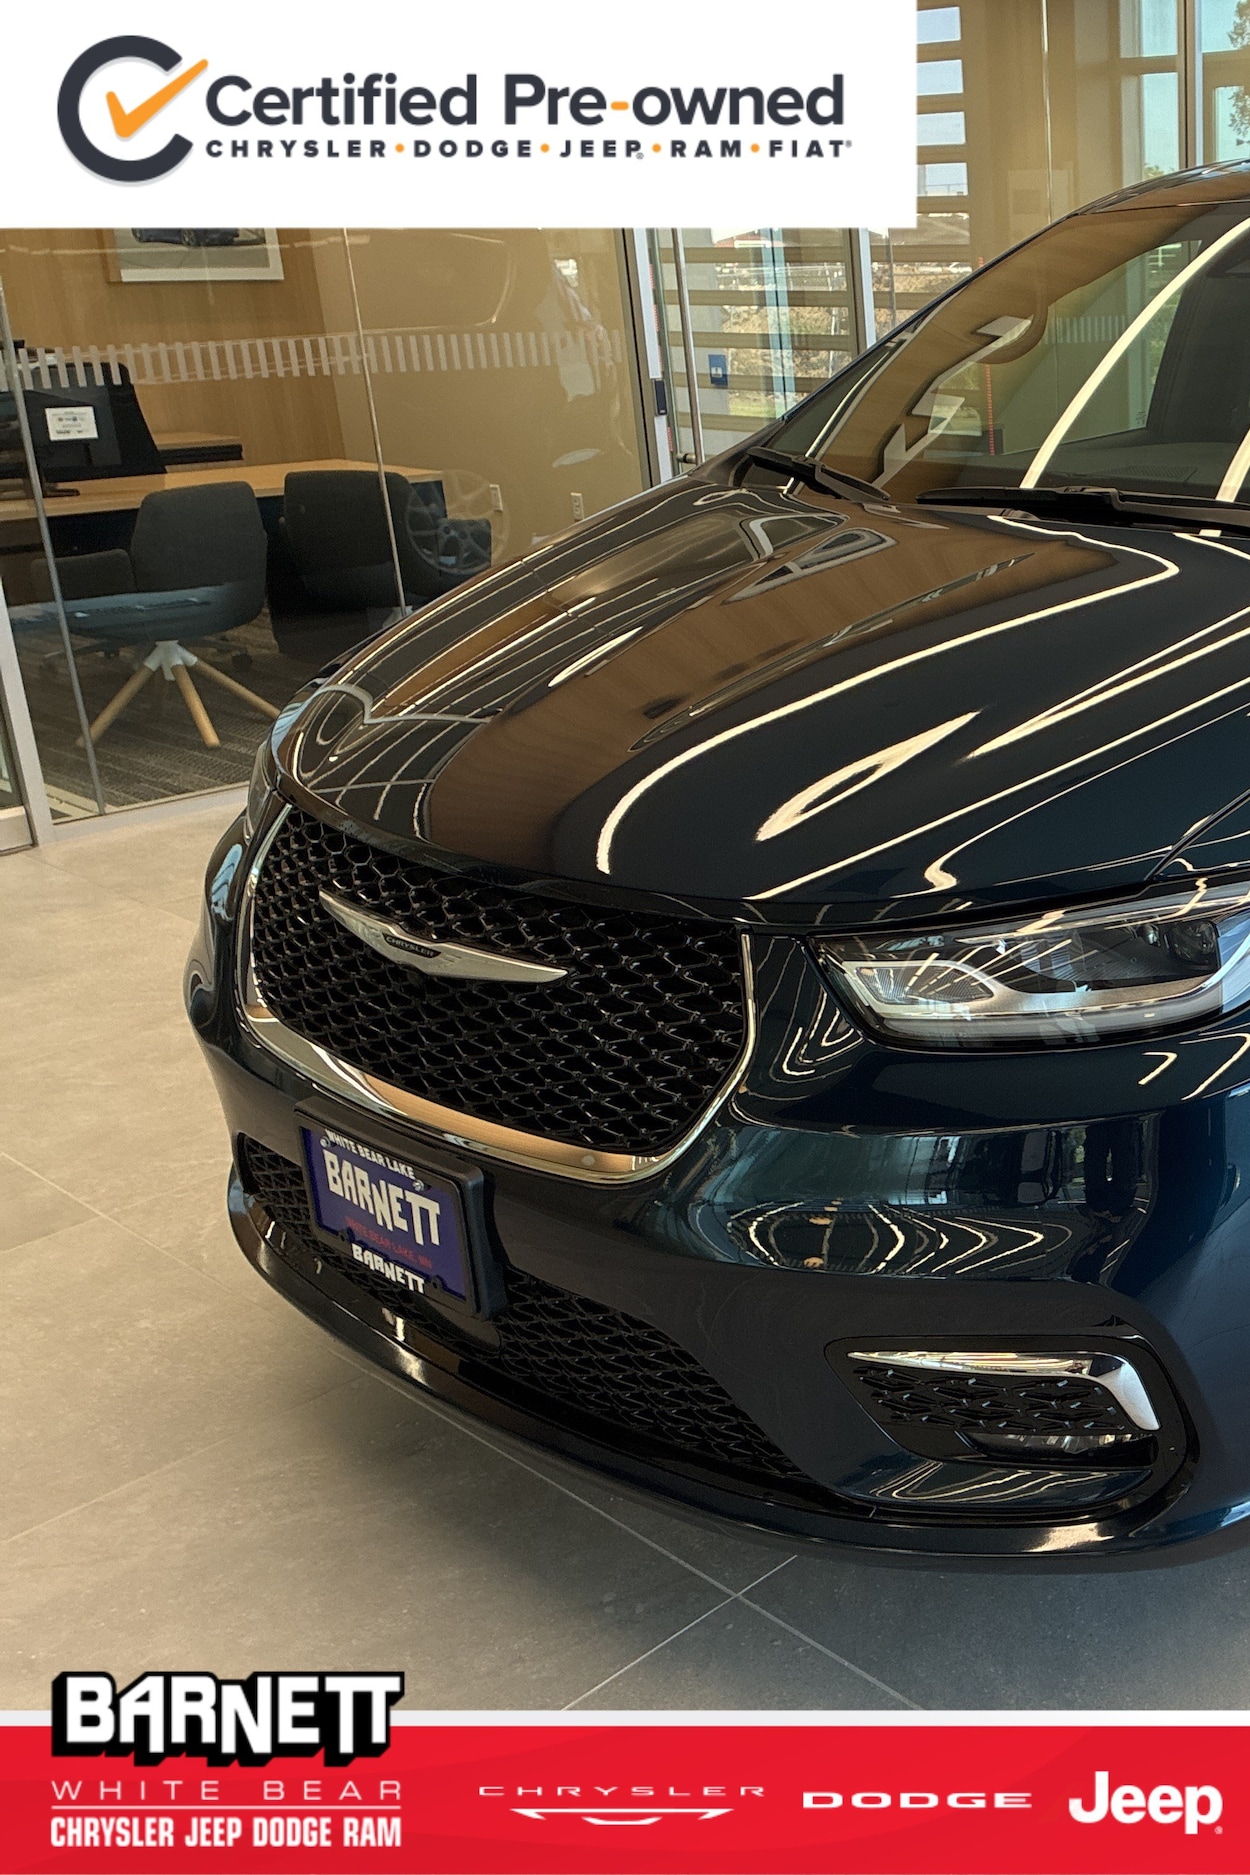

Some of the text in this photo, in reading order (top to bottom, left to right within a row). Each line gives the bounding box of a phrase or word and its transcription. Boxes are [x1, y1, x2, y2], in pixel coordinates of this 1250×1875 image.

[324, 1128, 416, 1180] WHITE BEAR LAKE
[322, 1149, 441, 1246] BARNETT
[351, 1242, 426, 1294] BARNETT
